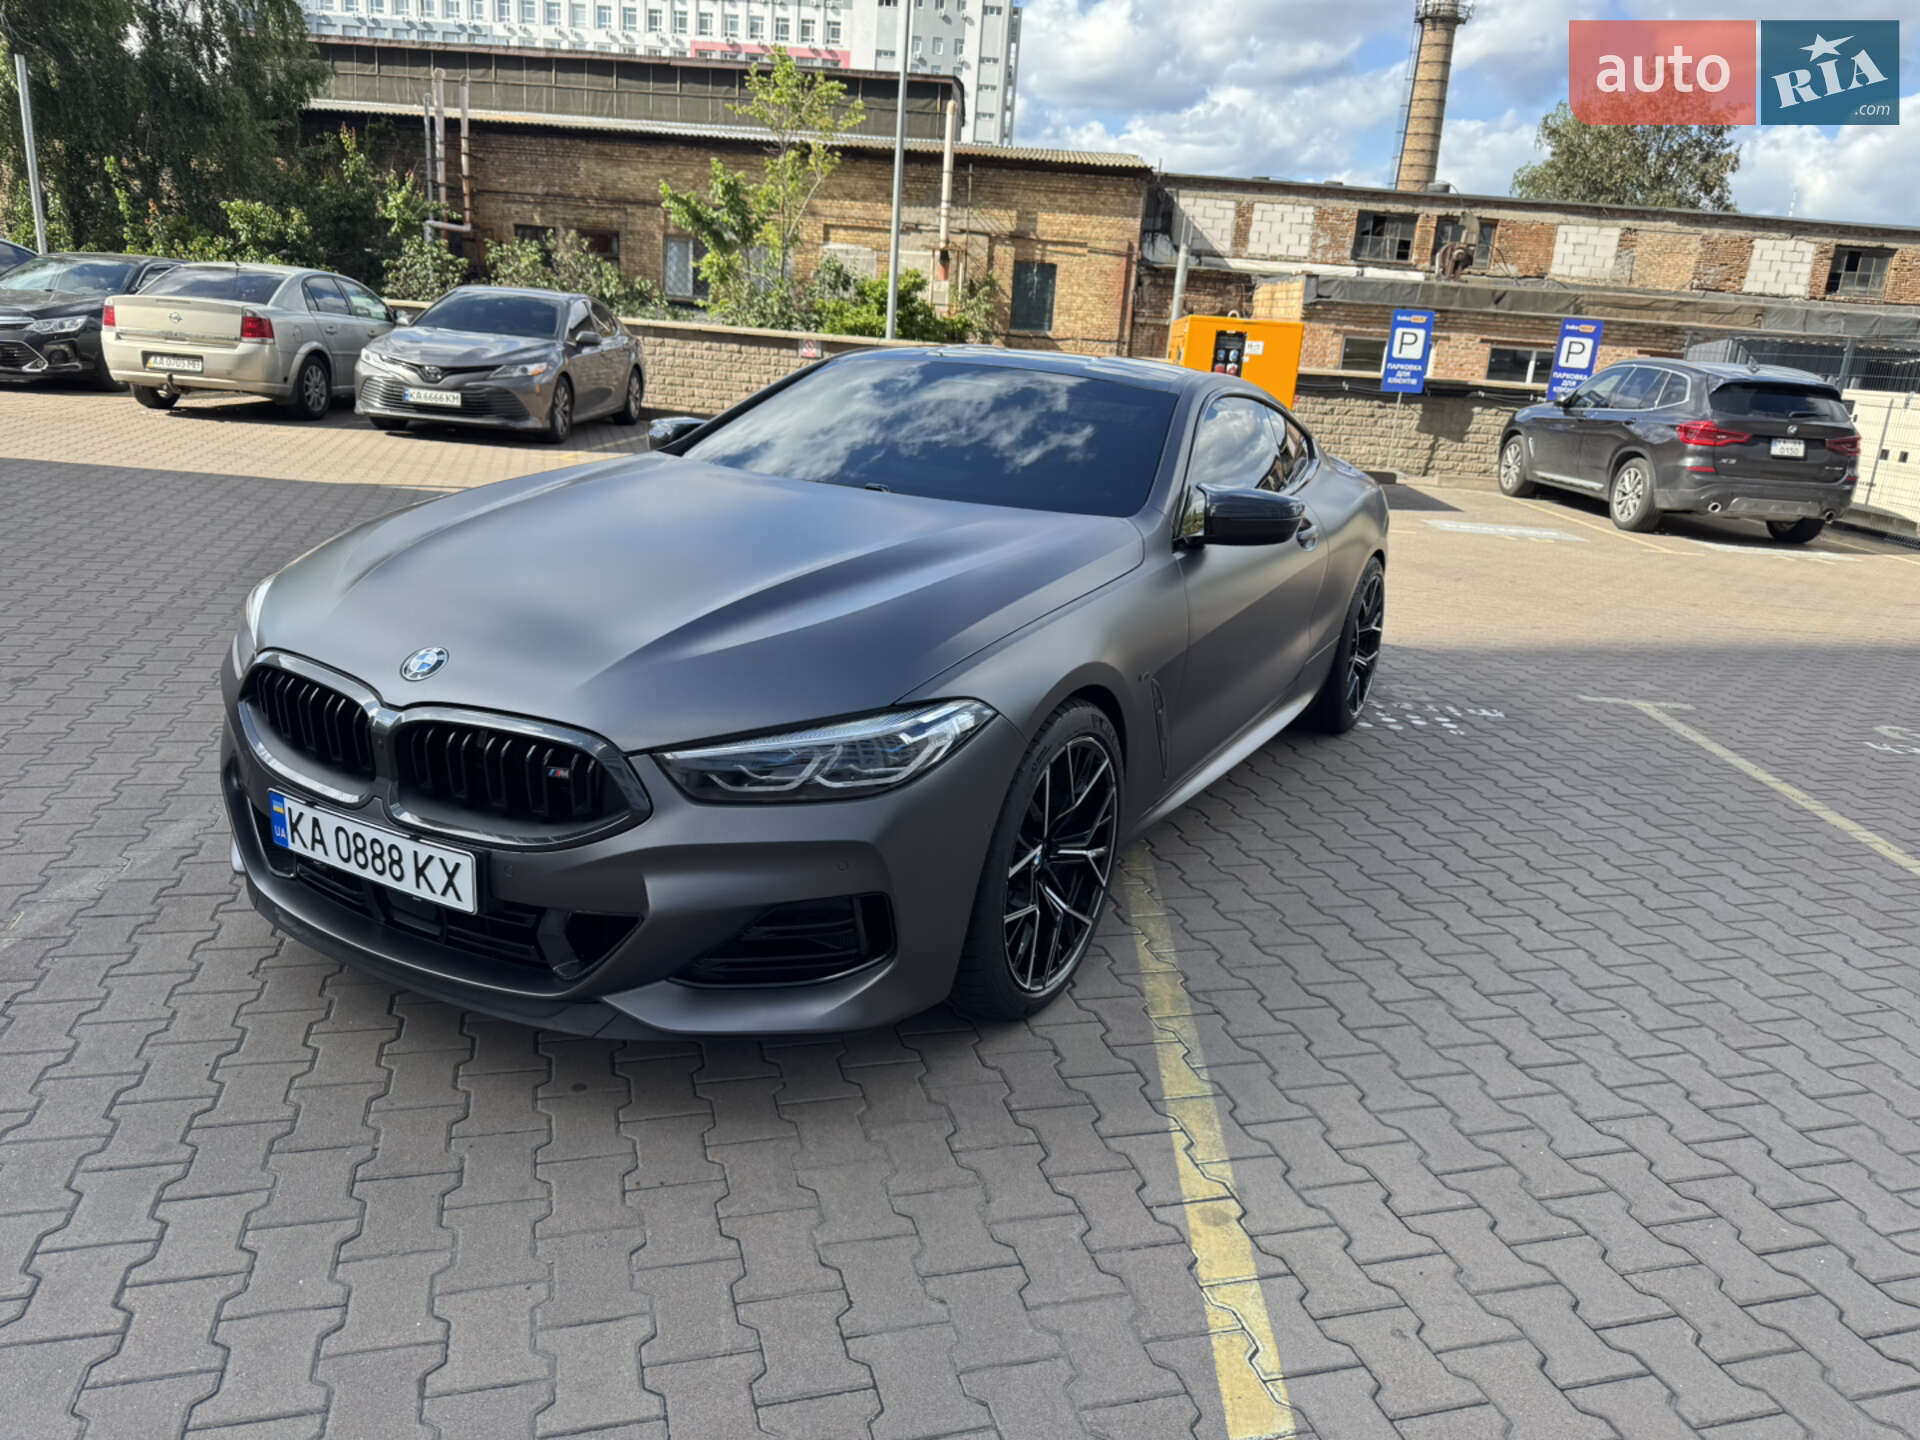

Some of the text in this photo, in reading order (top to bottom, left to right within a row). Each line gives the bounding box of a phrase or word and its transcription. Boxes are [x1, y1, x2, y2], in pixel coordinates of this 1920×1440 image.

[1399, 331, 1418, 354] P
[1565, 341, 1585, 363] P
[275, 825, 287, 839] UA
[287, 807, 463, 903] KA 0888 KX
